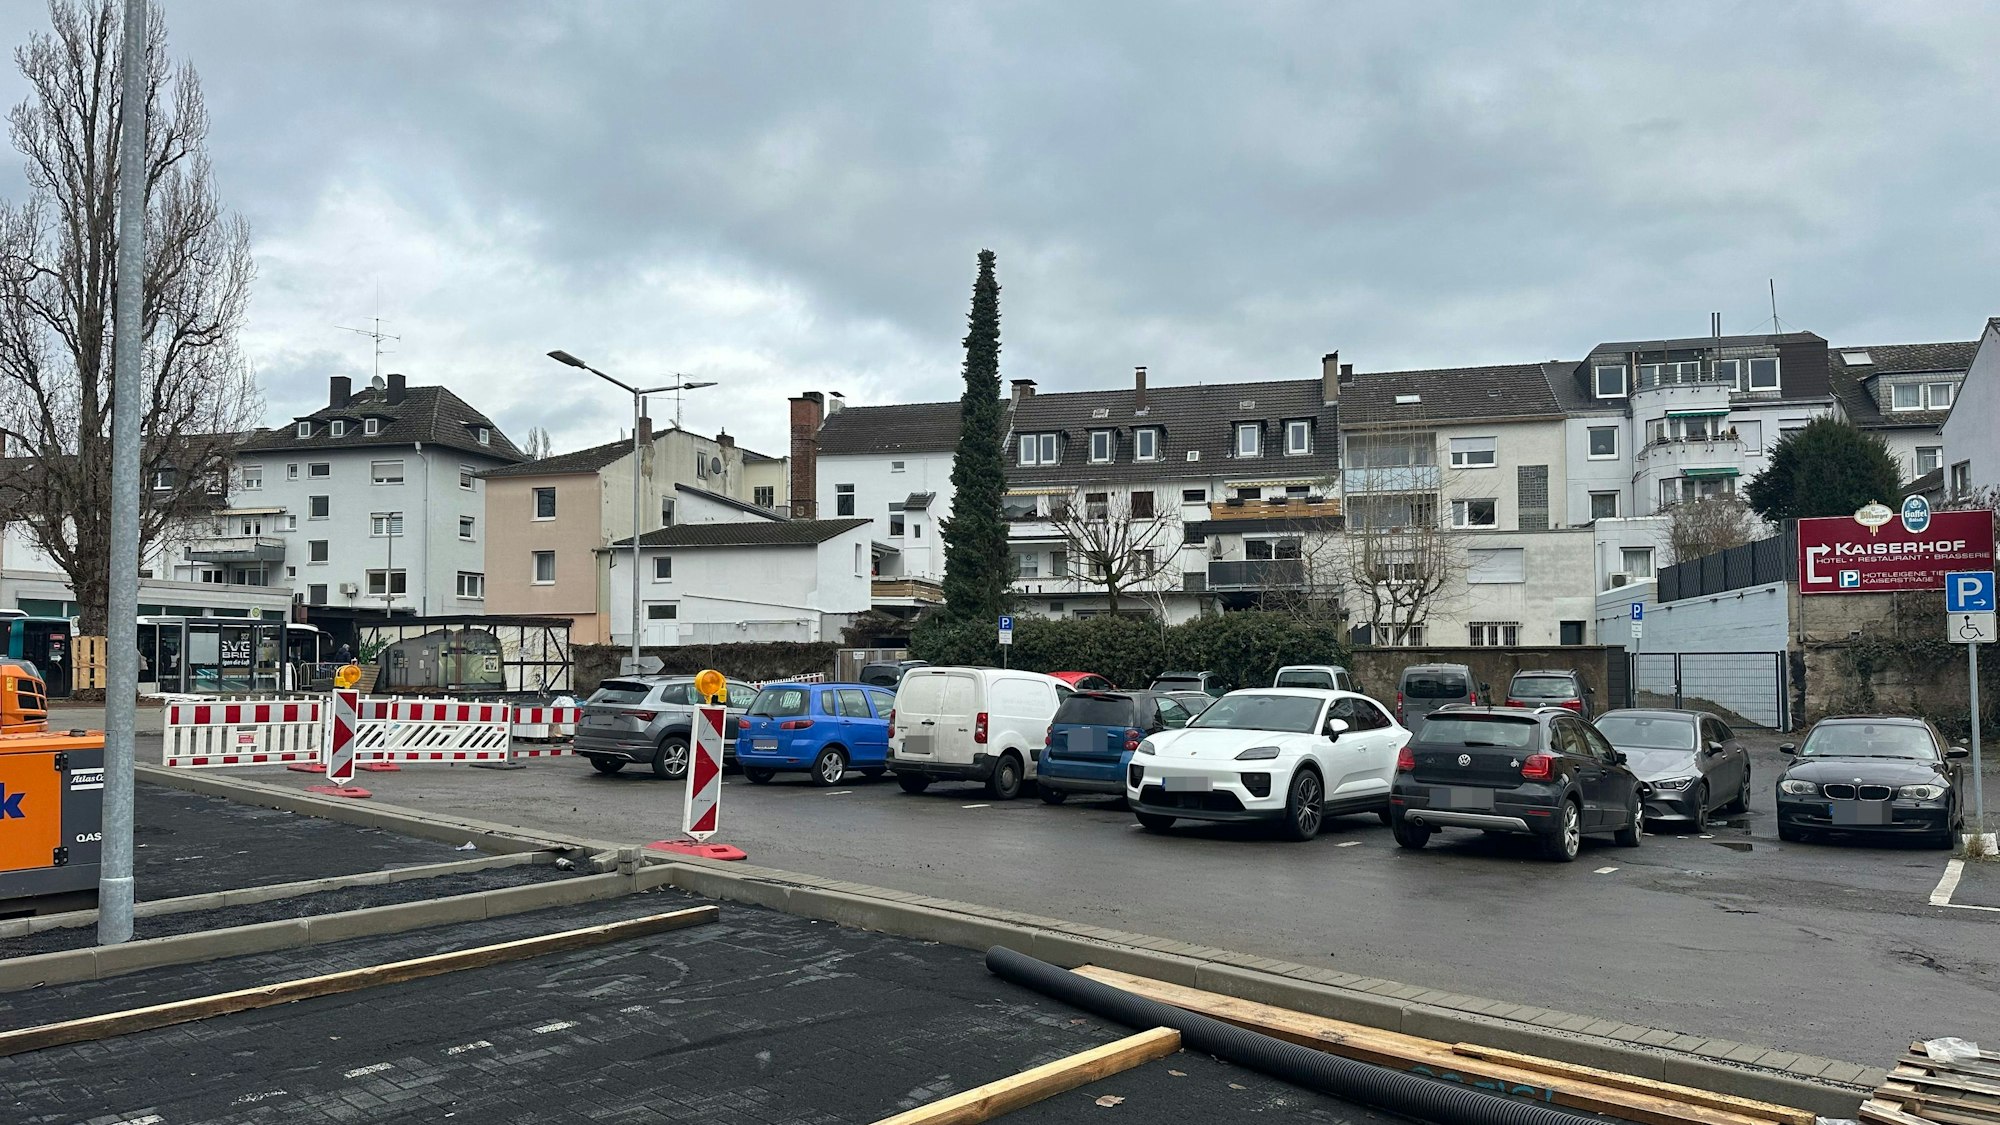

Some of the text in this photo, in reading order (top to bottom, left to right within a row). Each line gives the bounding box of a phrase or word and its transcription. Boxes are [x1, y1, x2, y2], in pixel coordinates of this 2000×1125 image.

[1904, 510, 1928, 518] Gaffel
[1835, 540, 1966, 556] KAISERHOF
[1857, 554, 1922, 563] RESTAURANT
[1933, 551, 1991, 560] BRASSERIE
[1843, 571, 1858, 587] P
[1862, 570, 1927, 578] HOTELEIGENE
[1957, 577, 1983, 607] P
[1633, 604, 1641, 619] P
[1001, 617, 1010, 629] P
[71, 775, 96, 783] Atlas
[76, 832, 102, 843] QAS
